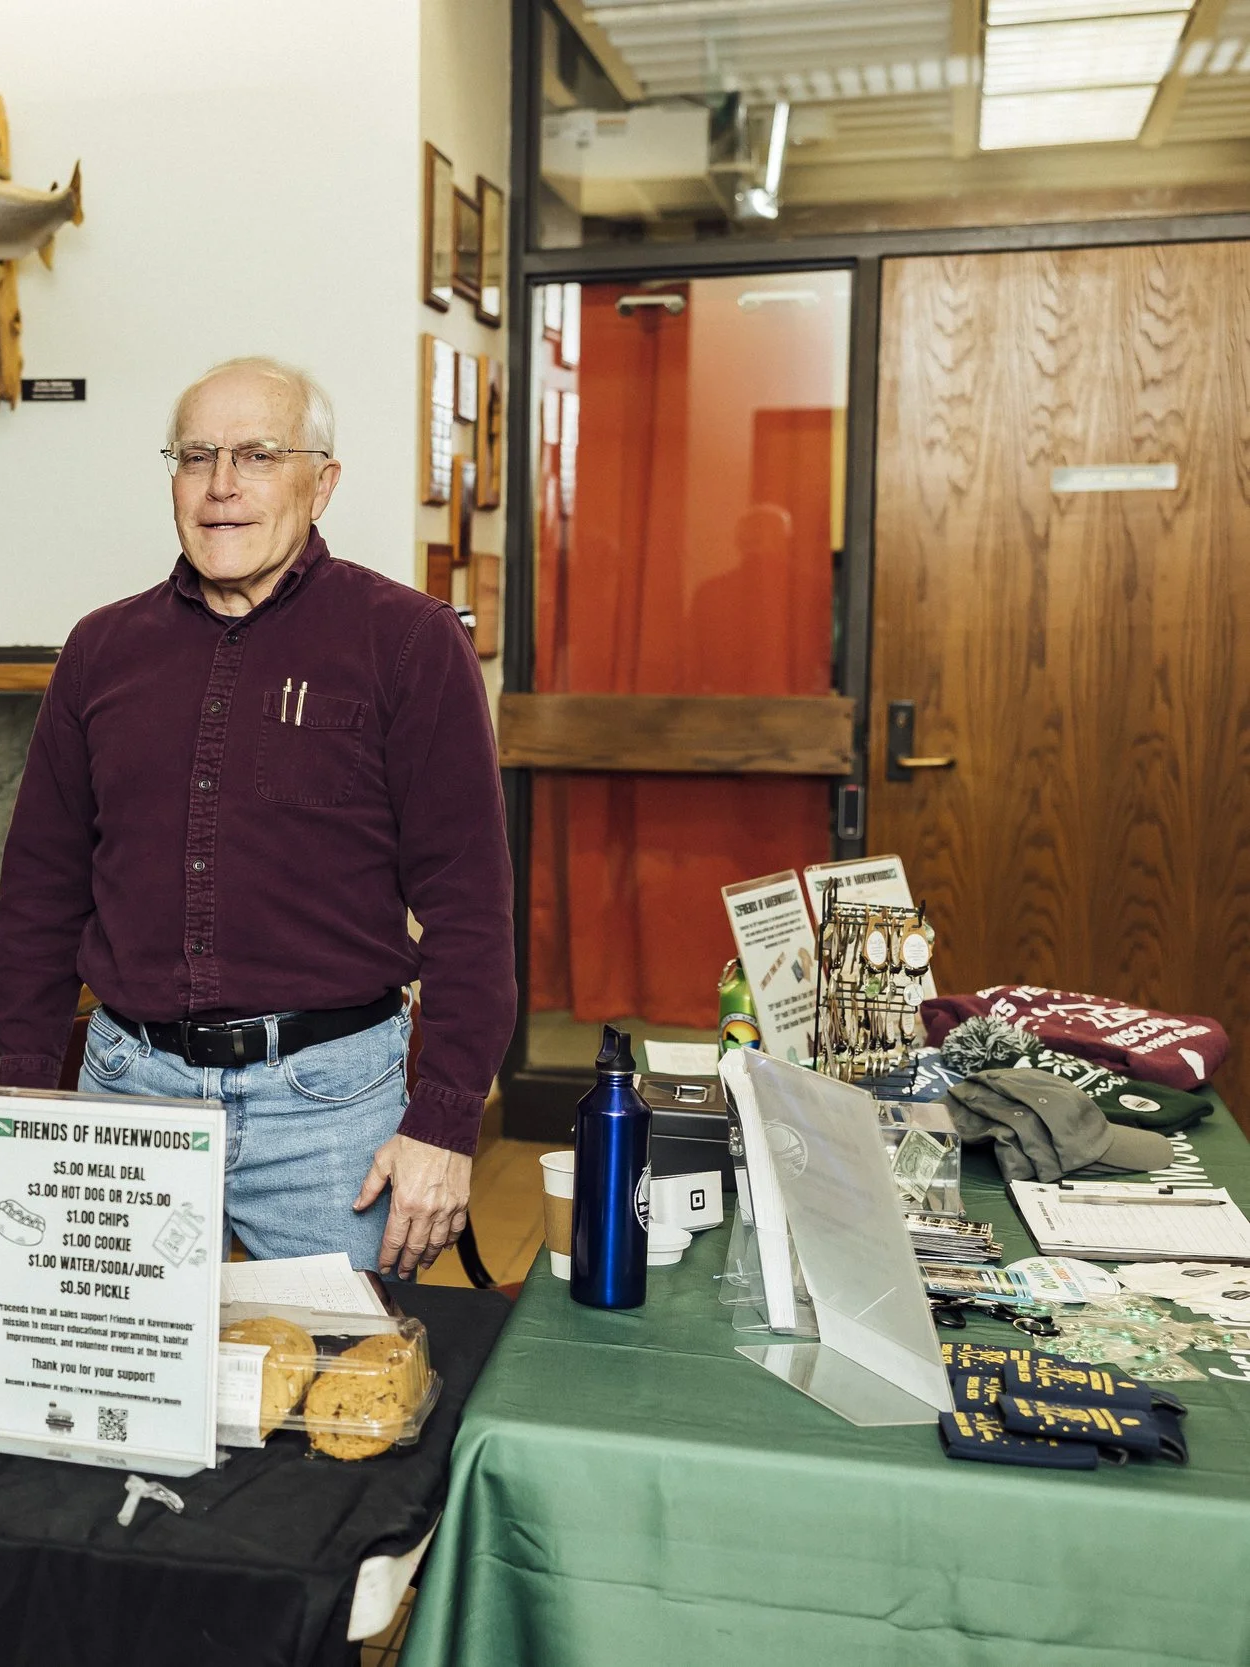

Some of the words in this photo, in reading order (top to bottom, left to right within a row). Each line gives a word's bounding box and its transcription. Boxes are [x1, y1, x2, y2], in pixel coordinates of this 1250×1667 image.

[13, 1120, 68, 1141] FRIENDS
[73, 1124, 89, 1143] OF
[94, 1126, 190, 1150] HAVENWOODS
[53, 1161, 84, 1176] $5.00
[87, 1163, 115, 1178] MEAL
[120, 1166, 146, 1181] DEAL
[27, 1183, 58, 1198] $3.00
[61, 1186, 81, 1200] HOT
[84, 1188, 105, 1202] DOG
[108, 1189, 122, 1203] OR
[126, 1191, 171, 1207] 2/$5.00
[66, 1209, 95, 1225] $1.00
[98, 1211, 129, 1228] CHIPS
[62, 1233, 91, 1248] $1.00
[94, 1235, 132, 1252] COOKIE
[28, 1254, 57, 1269] $1.00
[60, 1256, 166, 1280] WATER/SODA/JUICE
[60, 1281, 91, 1296] $0.50
[94, 1283, 130, 1300] PICKLE
[31, 1306, 47, 1315] from
[49, 1308, 57, 1316] all
[60, 1310, 78, 1319] sales
[81, 1312, 108, 1322] support
[110, 1314, 135, 1325] Friends
[2, 1317, 30, 1328] mission
[32, 1320, 38, 1329] to
[41, 1322, 65, 1332] ensure
[67, 1325, 108, 1336] educational
[163, 1336, 189, 1346] habitat
[61, 1339, 73, 1347] and
[76, 1340, 108, 1351] volunteer
[111, 1344, 134, 1354] events
[146, 1348, 157, 1357] the
[32, 1357, 57, 1371] Thank
[60, 1363, 76, 1374] you
[79, 1364, 91, 1375] for
[94, 1366, 114, 1378] your
[117, 1369, 156, 1383] support!
